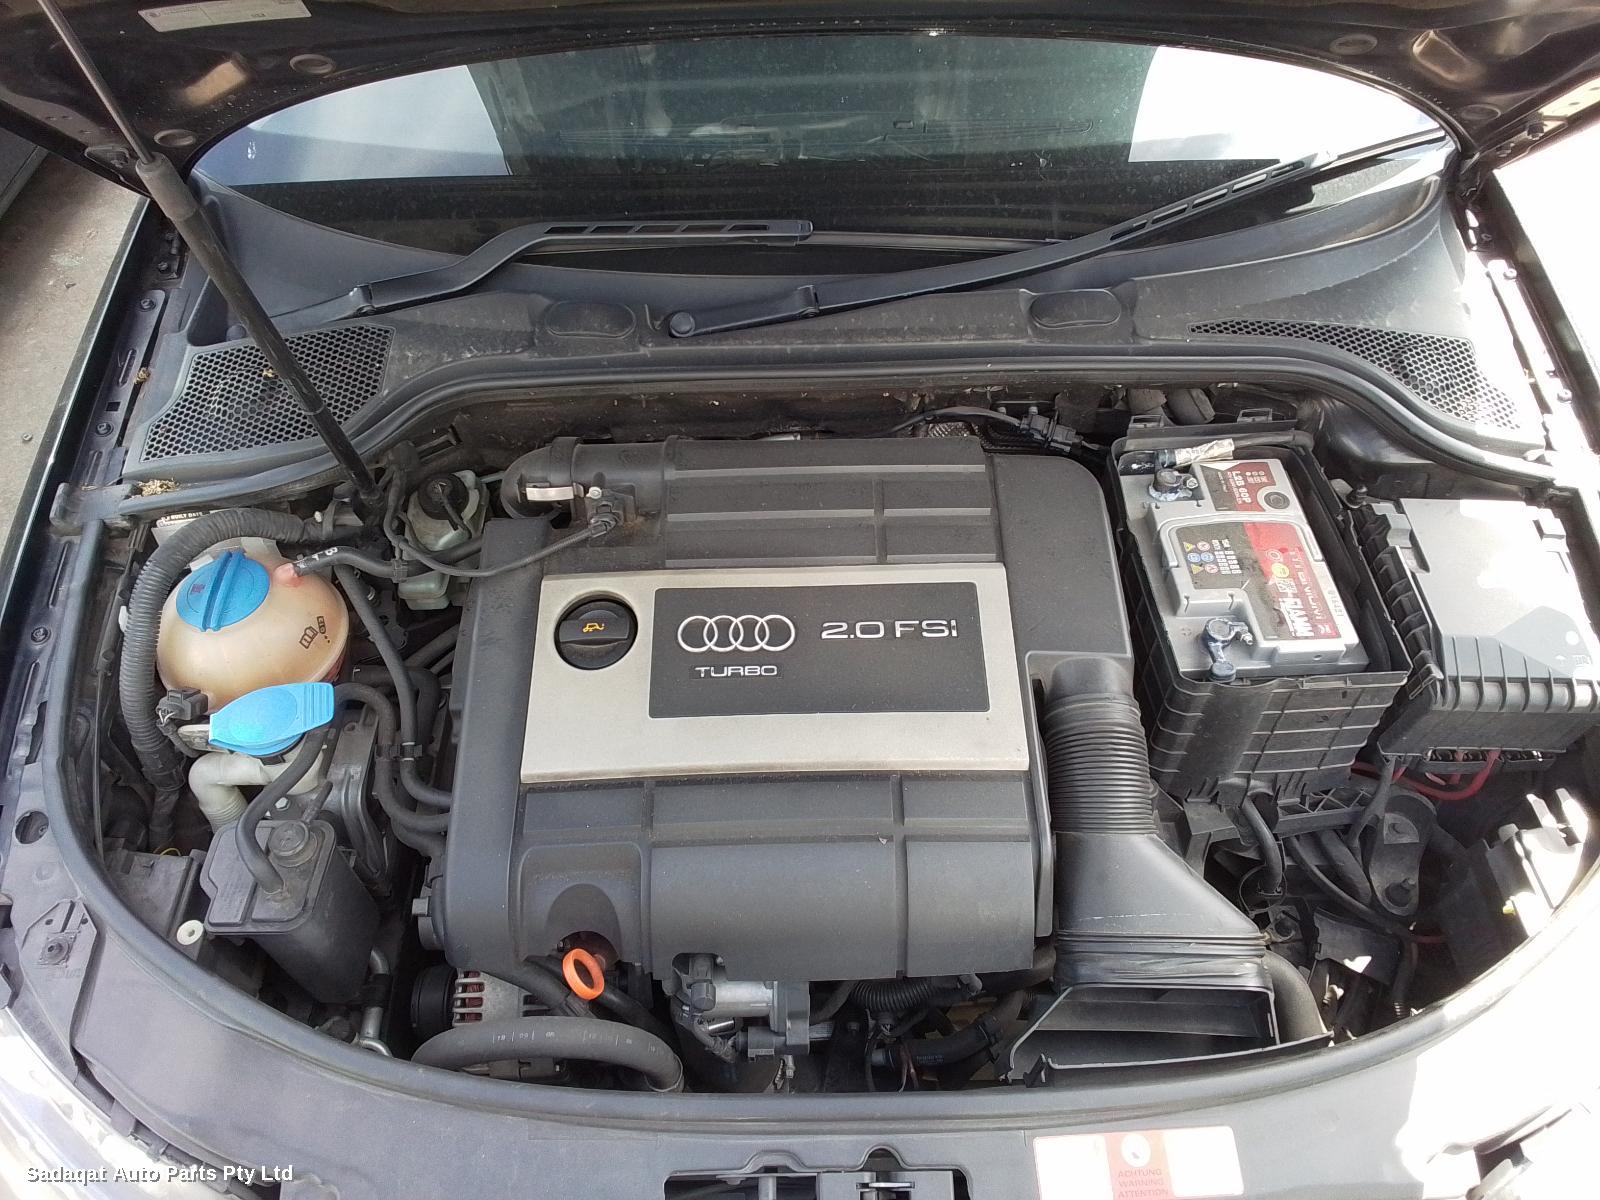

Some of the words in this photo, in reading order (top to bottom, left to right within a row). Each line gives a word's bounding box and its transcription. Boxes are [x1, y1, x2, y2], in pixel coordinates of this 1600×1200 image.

[821, 620, 886, 640] 2.0
[694, 665, 778, 678] TURBO
[1118, 1168, 1162, 1178] ACHTUNG
[1118, 1178, 1164, 1187] WARNING
